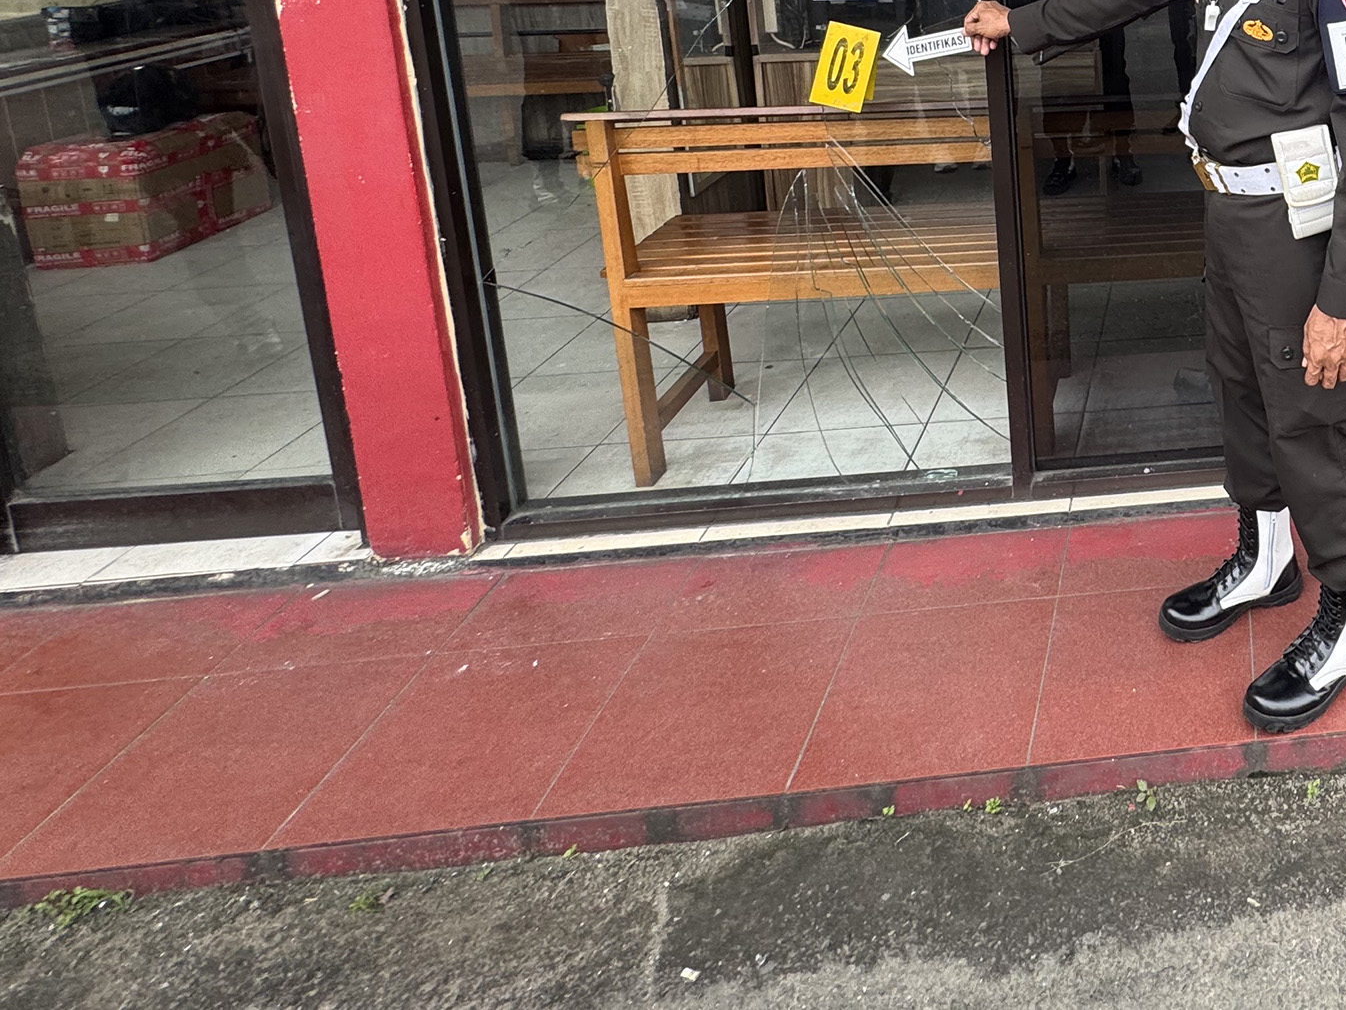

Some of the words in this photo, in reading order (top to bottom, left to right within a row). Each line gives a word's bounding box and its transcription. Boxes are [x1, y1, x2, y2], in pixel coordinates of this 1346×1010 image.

[907, 36, 966, 56] IDENTIFIKASI
[827, 37, 864, 94] 03
[27, 204, 79, 213] FRAGILE
